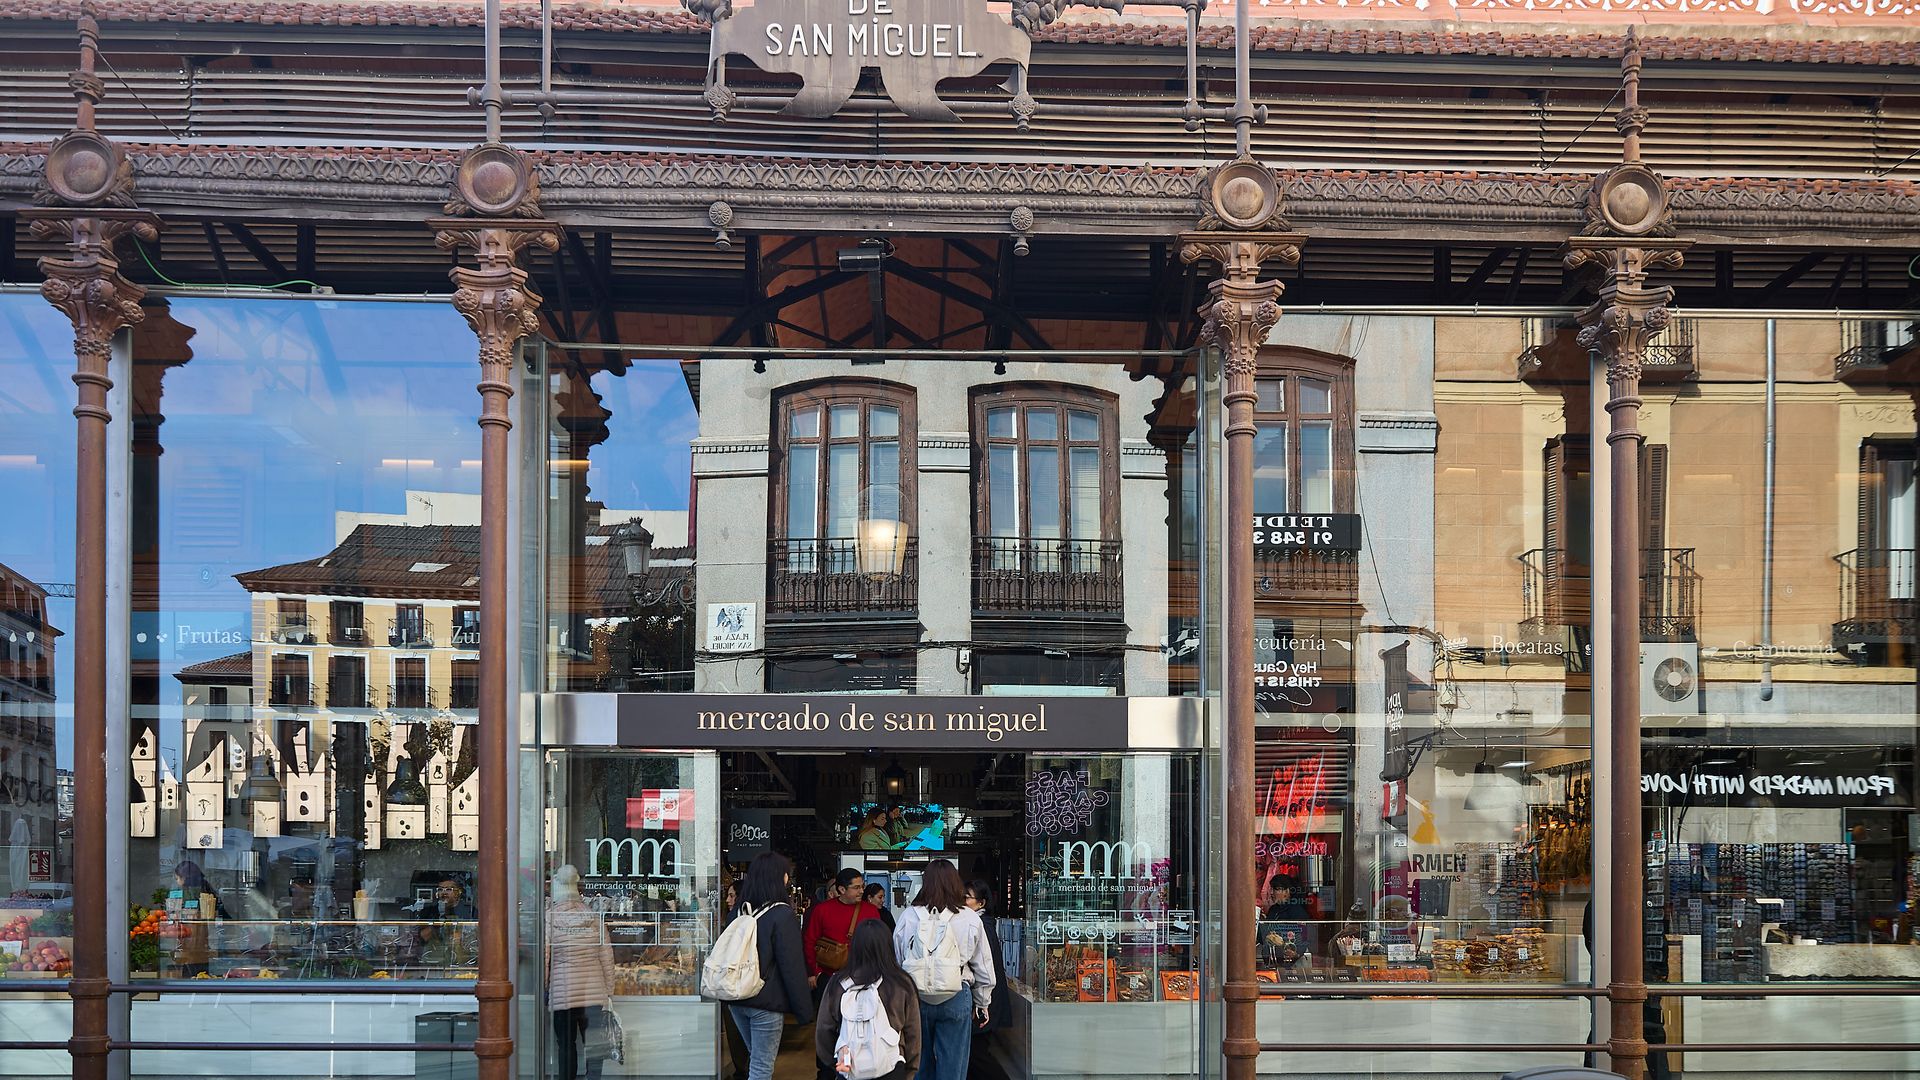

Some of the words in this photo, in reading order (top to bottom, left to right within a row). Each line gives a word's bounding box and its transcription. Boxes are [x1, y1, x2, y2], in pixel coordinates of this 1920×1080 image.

[766, 23, 833, 56] SAN
[177, 625, 242, 644] Frutas
[1491, 635, 1563, 655] Bocatas
[1733, 639, 1837, 658] Carnicería
[697, 702, 830, 732] mercado
[839, 702, 875, 732] de
[883, 711, 937, 732] san
[945, 703, 1048, 742] miguel
[585, 881, 624, 890] mercado
[625, 881, 636, 890] de
[1058, 882, 1096, 892] mercado
[1098, 881, 1109, 892] de
[1110, 884, 1126, 892] san
[1128, 882, 1157, 894] miguel
